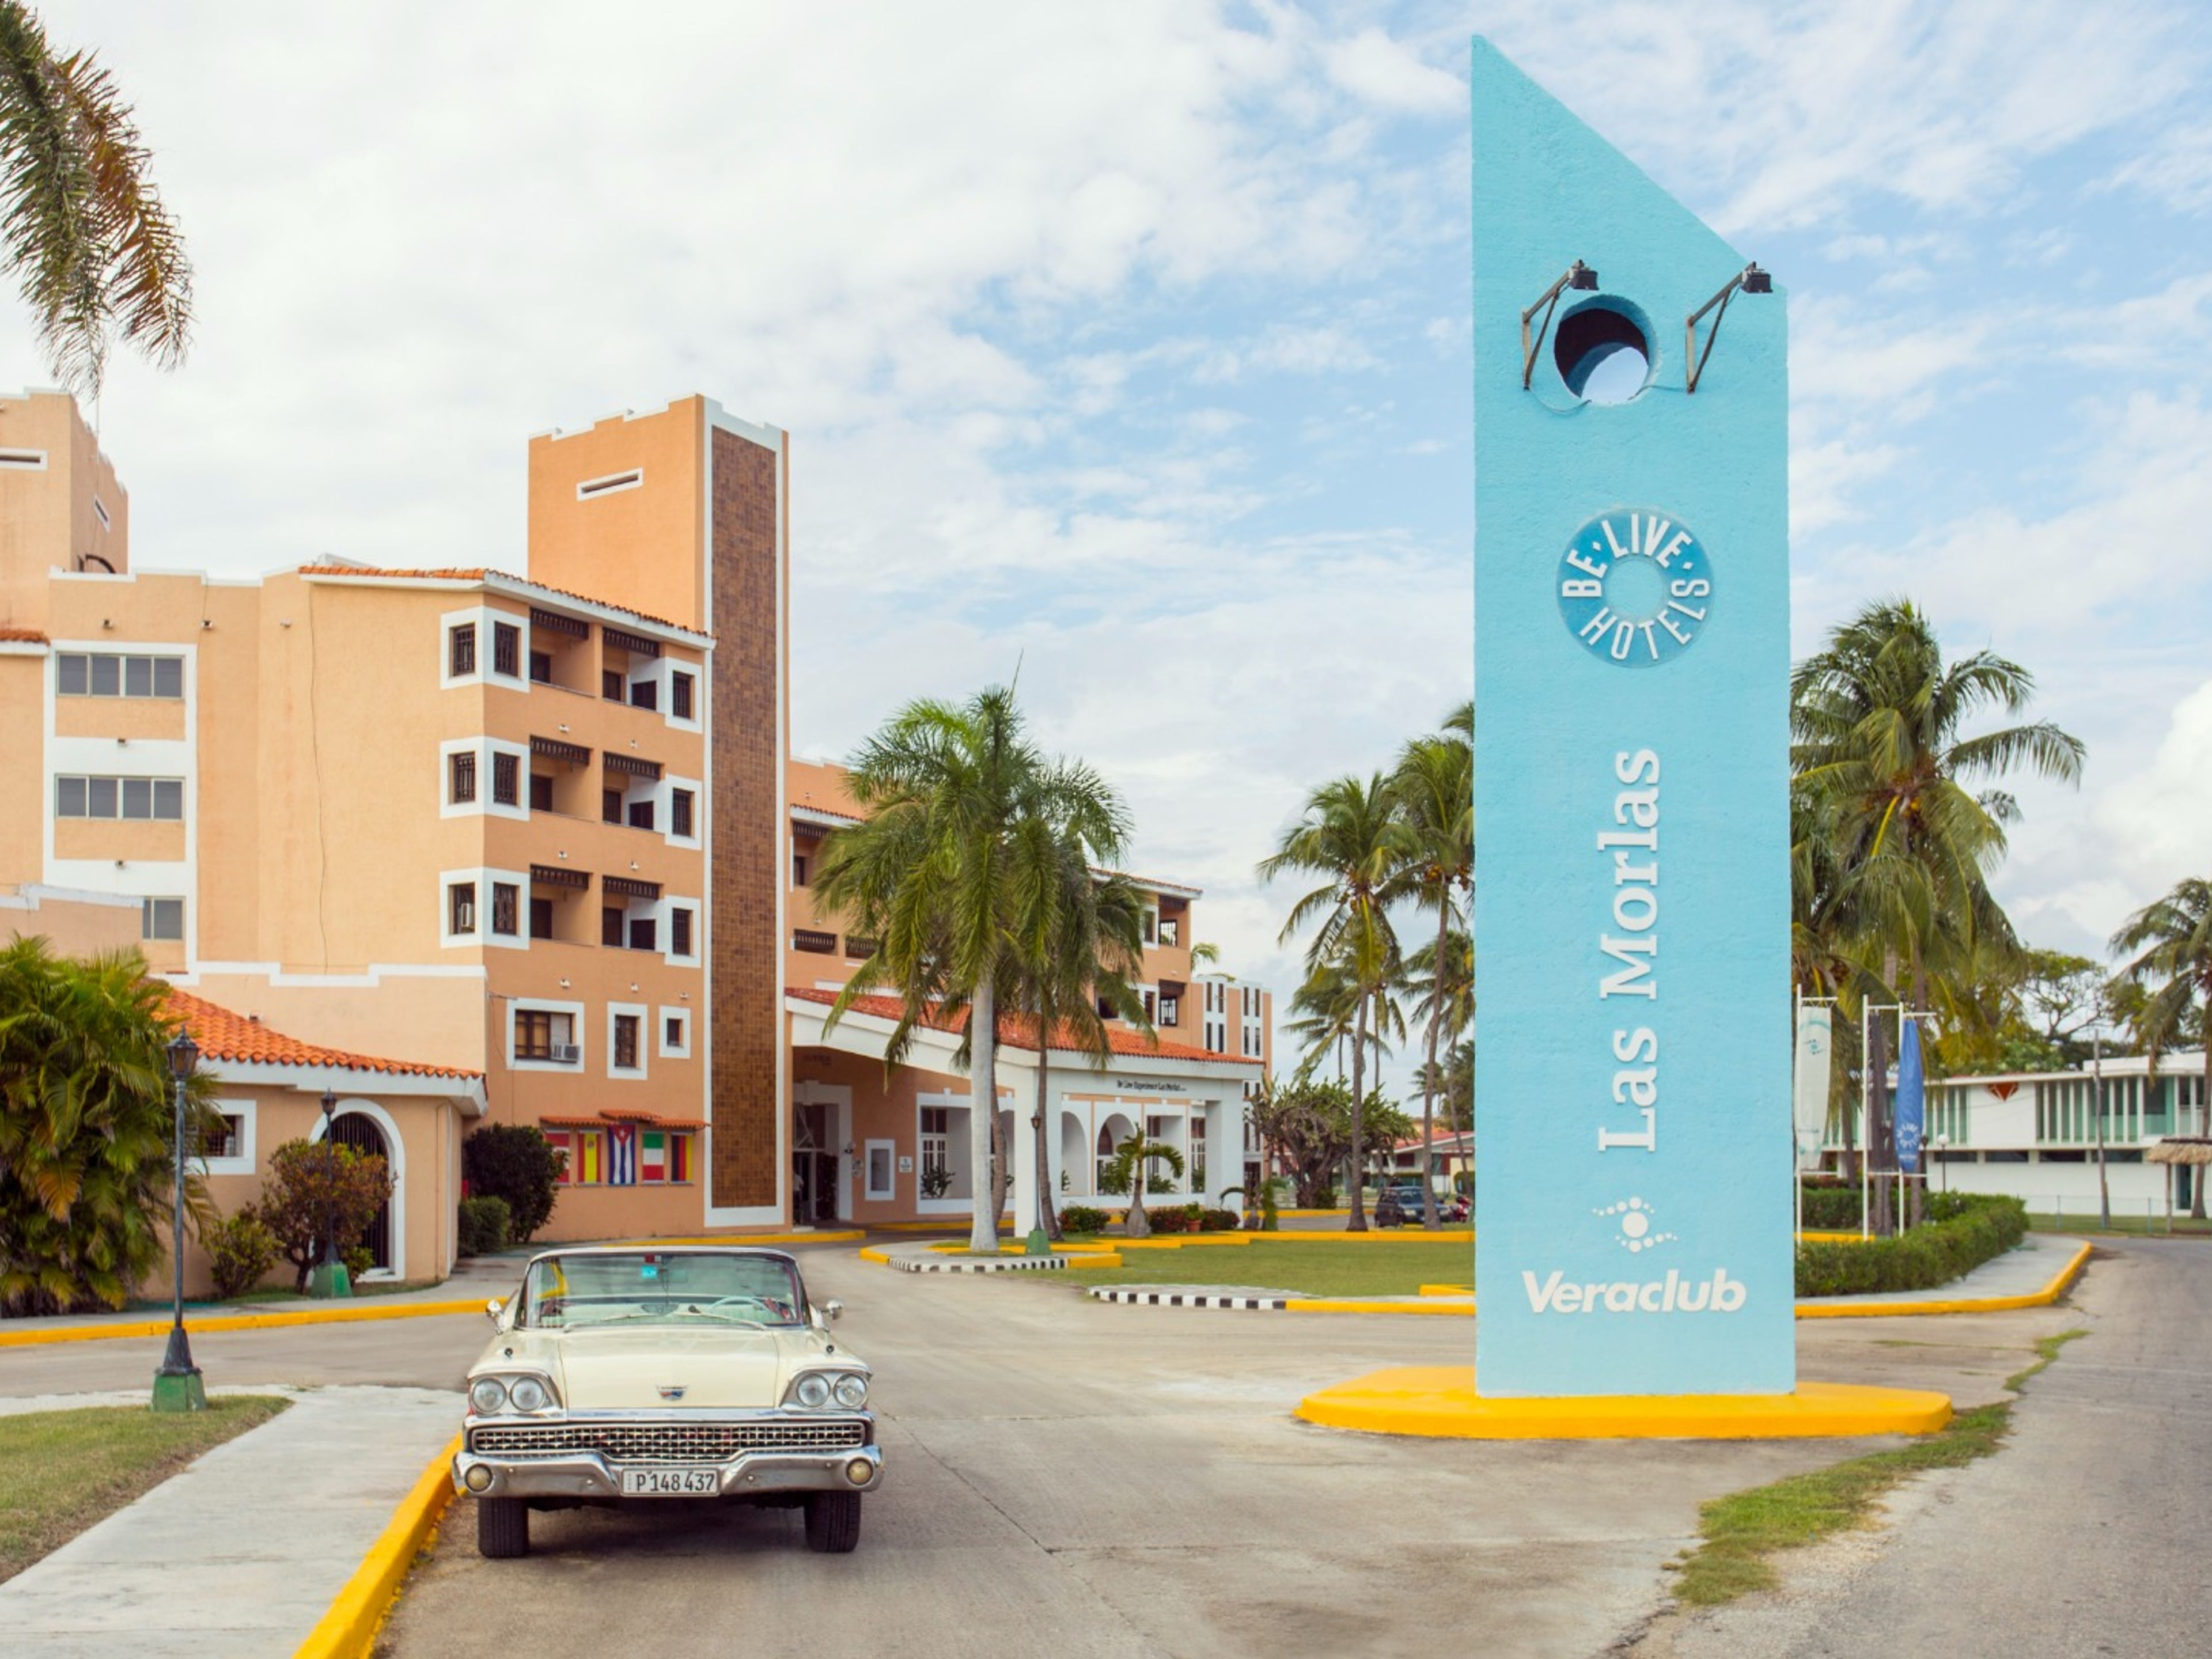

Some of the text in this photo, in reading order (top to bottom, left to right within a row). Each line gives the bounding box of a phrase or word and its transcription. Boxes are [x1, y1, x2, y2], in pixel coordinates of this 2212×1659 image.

[1562, 513, 1692, 597] BE LIVE
[1579, 579, 1710, 660] HOTELS
[1596, 748, 1660, 1152] Las Morlas
[1521, 1267, 1748, 1315] Veraclub
